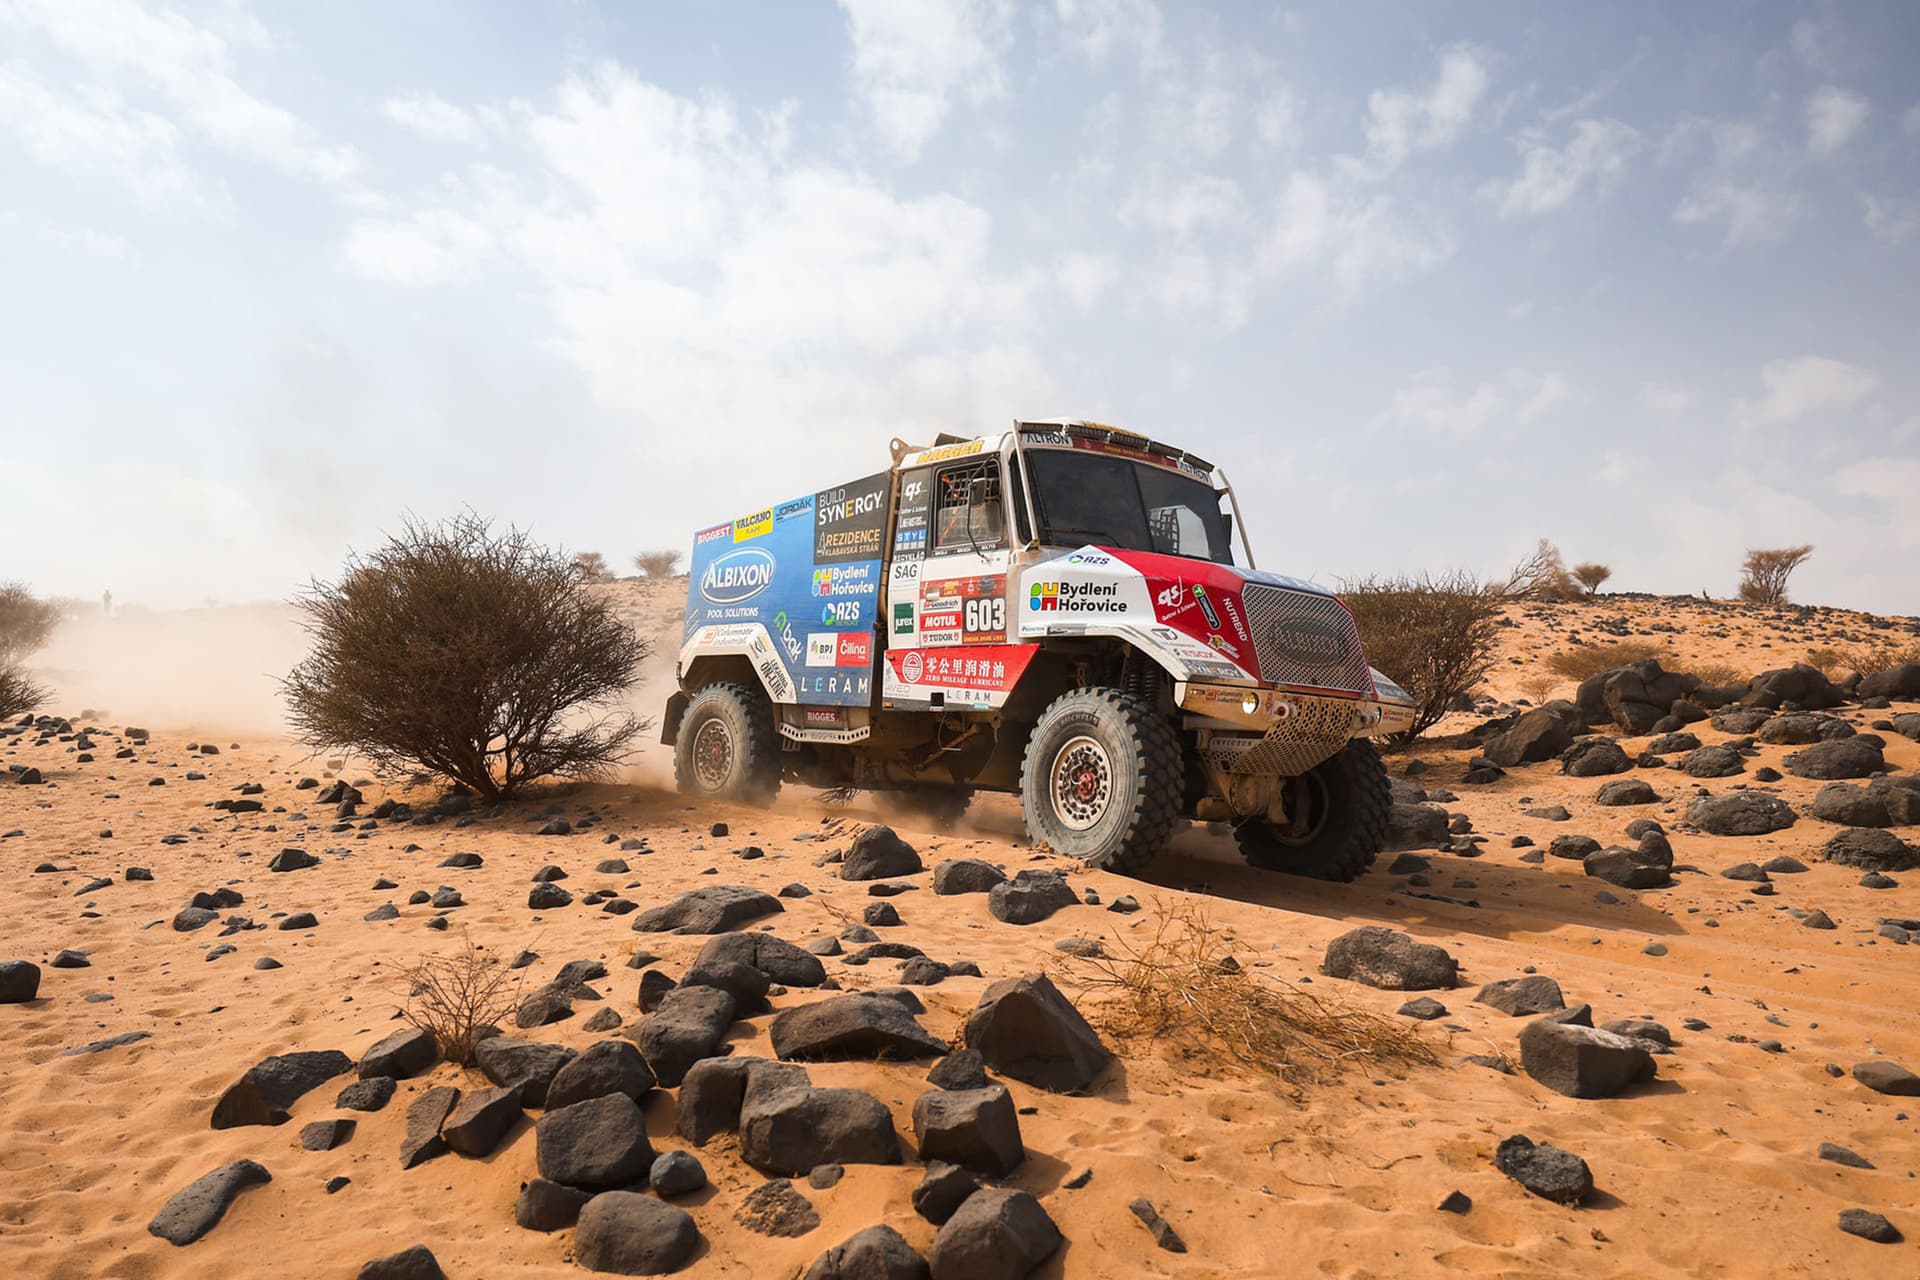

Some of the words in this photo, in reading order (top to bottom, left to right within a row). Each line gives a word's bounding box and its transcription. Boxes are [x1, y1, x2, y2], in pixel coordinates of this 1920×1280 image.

[819, 488, 846, 508] BUILD
[818, 490, 884, 526] SYNERGY
[735, 510, 772, 530] VALCANO
[697, 526, 731, 545] BIGGEST
[826, 528, 881, 547] REZIDENCE
[1083, 555, 1110, 566] AZS
[703, 562, 772, 590] ALBIXON
[832, 565, 869, 583] Bydlení
[894, 563, 918, 579] SAG
[831, 582, 875, 596] Hořovice
[1059, 582, 1118, 598] Bydlení
[706, 608, 723, 619] POOL
[725, 606, 759, 618] SOLUTIONS
[836, 601, 860, 621] AZS
[965, 597, 1006, 632] 603
[1059, 598, 1128, 613] Hořovice
[925, 615, 957, 627] MOTUL
[1223, 597, 1248, 641] NUTREND
[929, 632, 953, 642] TUDOR
[926, 657, 1005, 678] 零公里润滑油
[760, 661, 786, 700] ON-LINE
